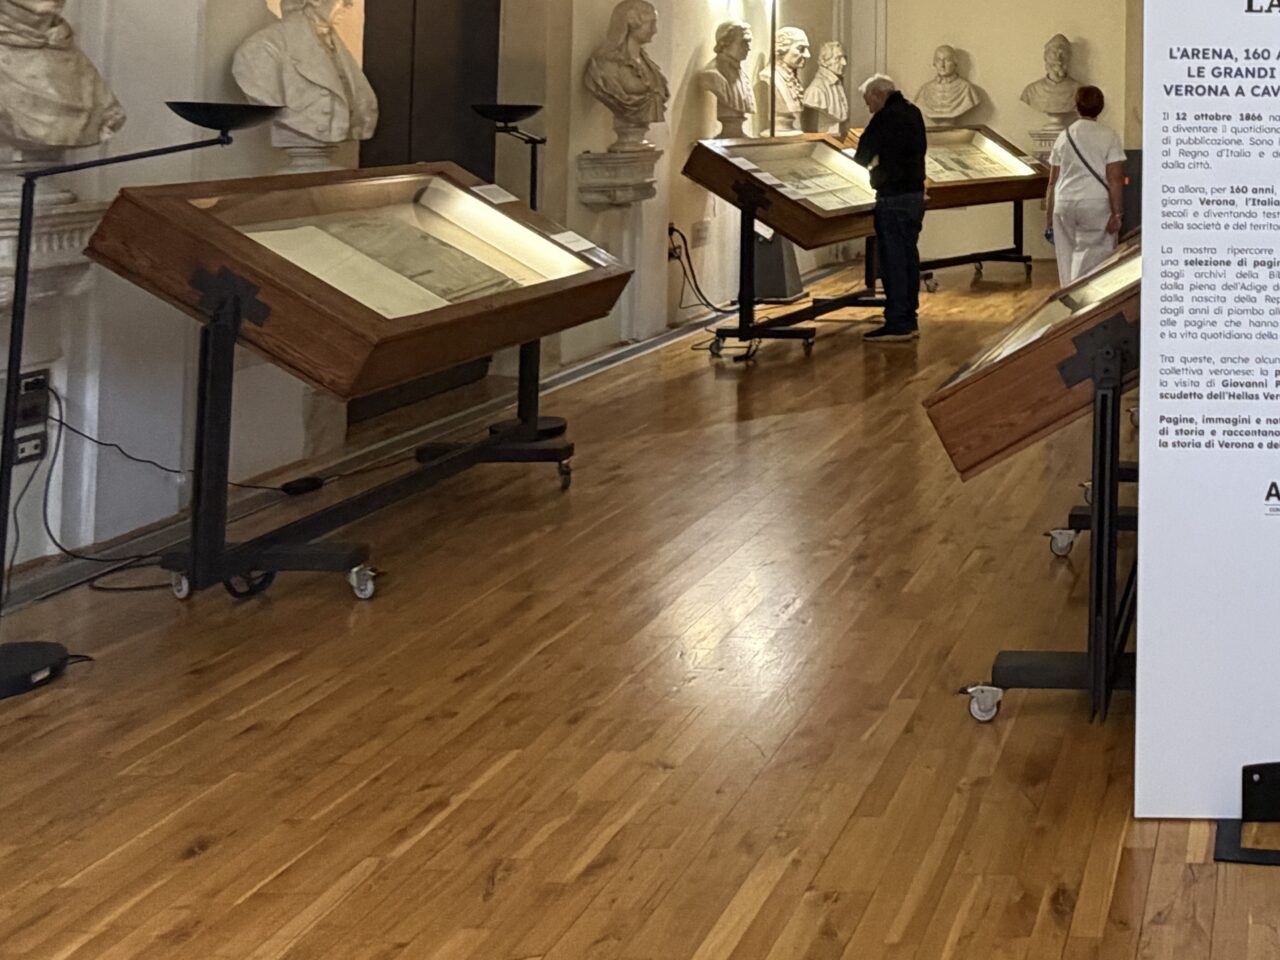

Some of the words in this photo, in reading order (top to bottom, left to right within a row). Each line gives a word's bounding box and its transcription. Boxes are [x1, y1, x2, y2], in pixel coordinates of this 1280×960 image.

[1169, 47, 1238, 62] L'ARENA,
[1244, 48, 1271, 60] 160
[1187, 66, 1206, 78] LE
[1211, 66, 1276, 79] GRANDI
[1163, 84, 1230, 96] VERONA
[1234, 85, 1246, 97] A
[1163, 112, 1169, 120] Il
[1176, 112, 1187, 121] 12
[1194, 112, 1232, 121] ottobre
[1239, 113, 1263, 121] 1866
[1172, 124, 1218, 133] diventare
[1162, 136, 1171, 145] di
[1249, 137, 1274, 146] Sono
[1178, 149, 1209, 159] Regno
[1188, 161, 1212, 169] città.
[1162, 185, 1175, 193] Da
[1210, 187, 1227, 195] per
[1230, 185, 1248, 194] 160
[1161, 197, 1192, 208] giorno
[1245, 197, 1280, 206] l'Italia
[1203, 210, 1258, 218] diventando
[1186, 222, 1221, 230] società
[1232, 222, 1247, 230] del
[1161, 246, 1173, 254] La
[1227, 247, 1274, 257] ripercorre
[1184, 257, 1232, 267] selezione
[1237, 257, 1247, 267] di
[1192, 295, 1226, 303] nascita
[1188, 306, 1209, 315] anni
[1227, 307, 1264, 317] piombo
[1184, 319, 1217, 329] pagine
[1224, 319, 1242, 327] che
[1249, 319, 1279, 327] hanno
[1180, 331, 1198, 340] vita
[1200, 330, 1253, 341] quotidiana
[1160, 354, 1174, 363] Tra
[1180, 356, 1215, 365] queste,
[1220, 356, 1250, 364] anche
[1174, 379, 1200, 387] visita
[1221, 379, 1268, 388] Giovanni
[1159, 391, 1204, 400] scudetto
[1206, 391, 1260, 400] dell'Hellas
[1159, 414, 1198, 426] Pagine,
[1202, 415, 1251, 427] immagini
[1158, 427, 1169, 436] di
[1175, 427, 1205, 436] storia
[1158, 439, 1168, 448] la
[1172, 439, 1202, 448] storia
[1204, 439, 1214, 448] di
[1218, 440, 1254, 448] Verona
